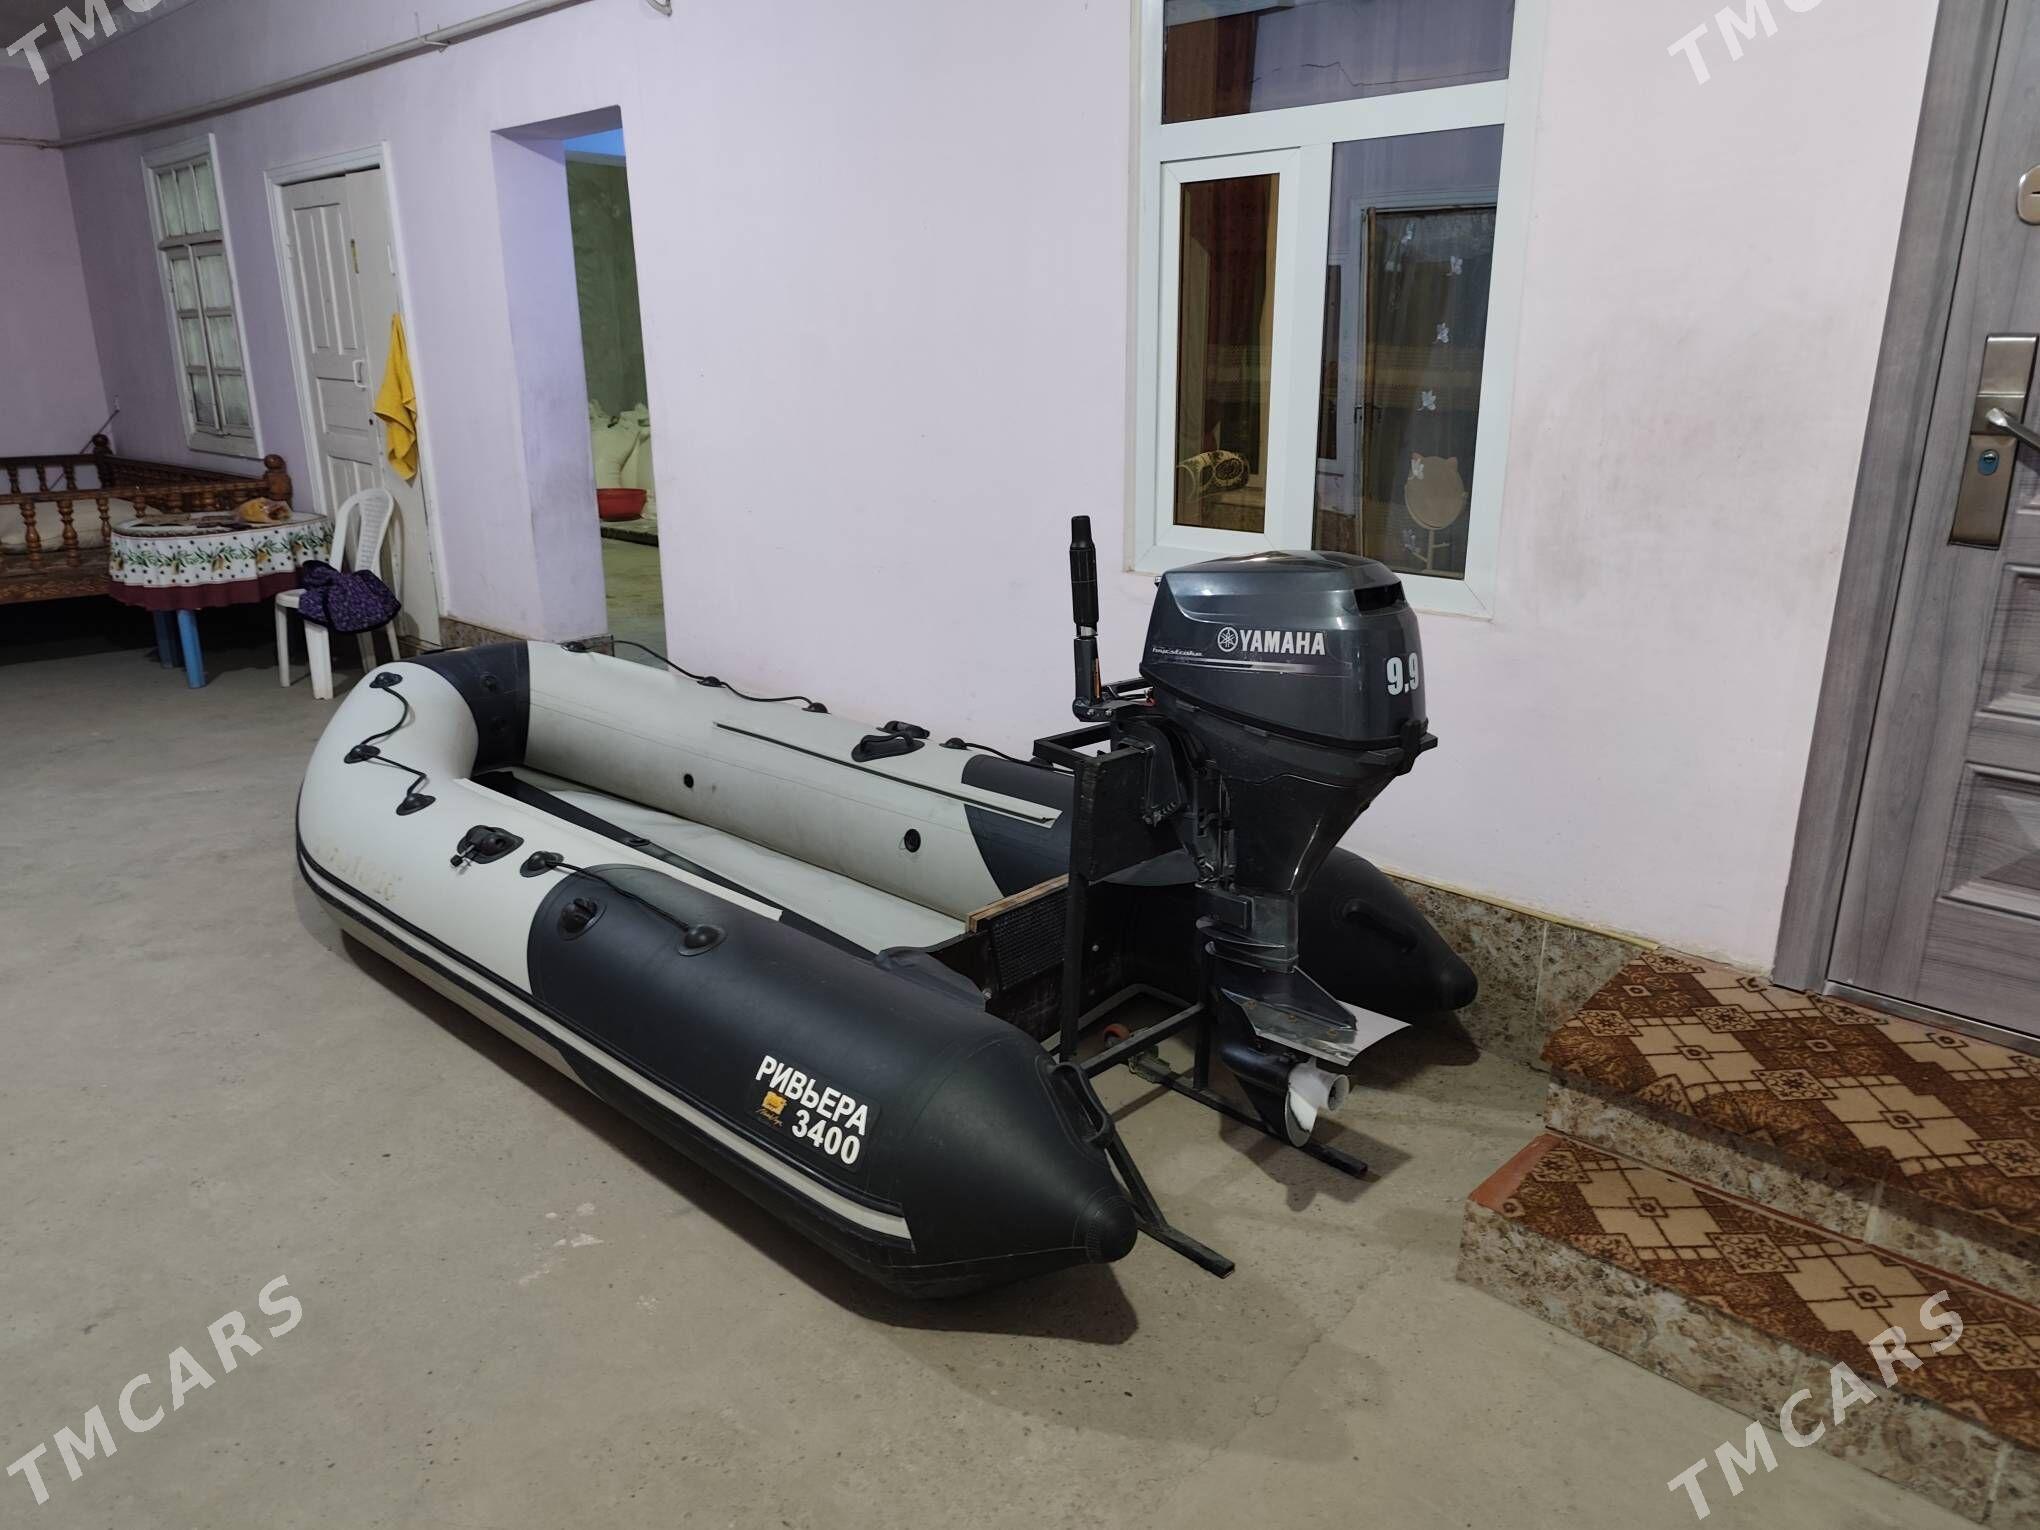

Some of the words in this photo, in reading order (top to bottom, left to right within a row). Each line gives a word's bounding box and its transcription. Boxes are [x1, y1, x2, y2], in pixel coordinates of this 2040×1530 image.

[1240, 629, 1326, 655] YAMAHA
[1386, 652, 1419, 695] 9.9
[755, 1055, 868, 1136] РИВЬЕРА
[791, 1109, 861, 1165] 3400
